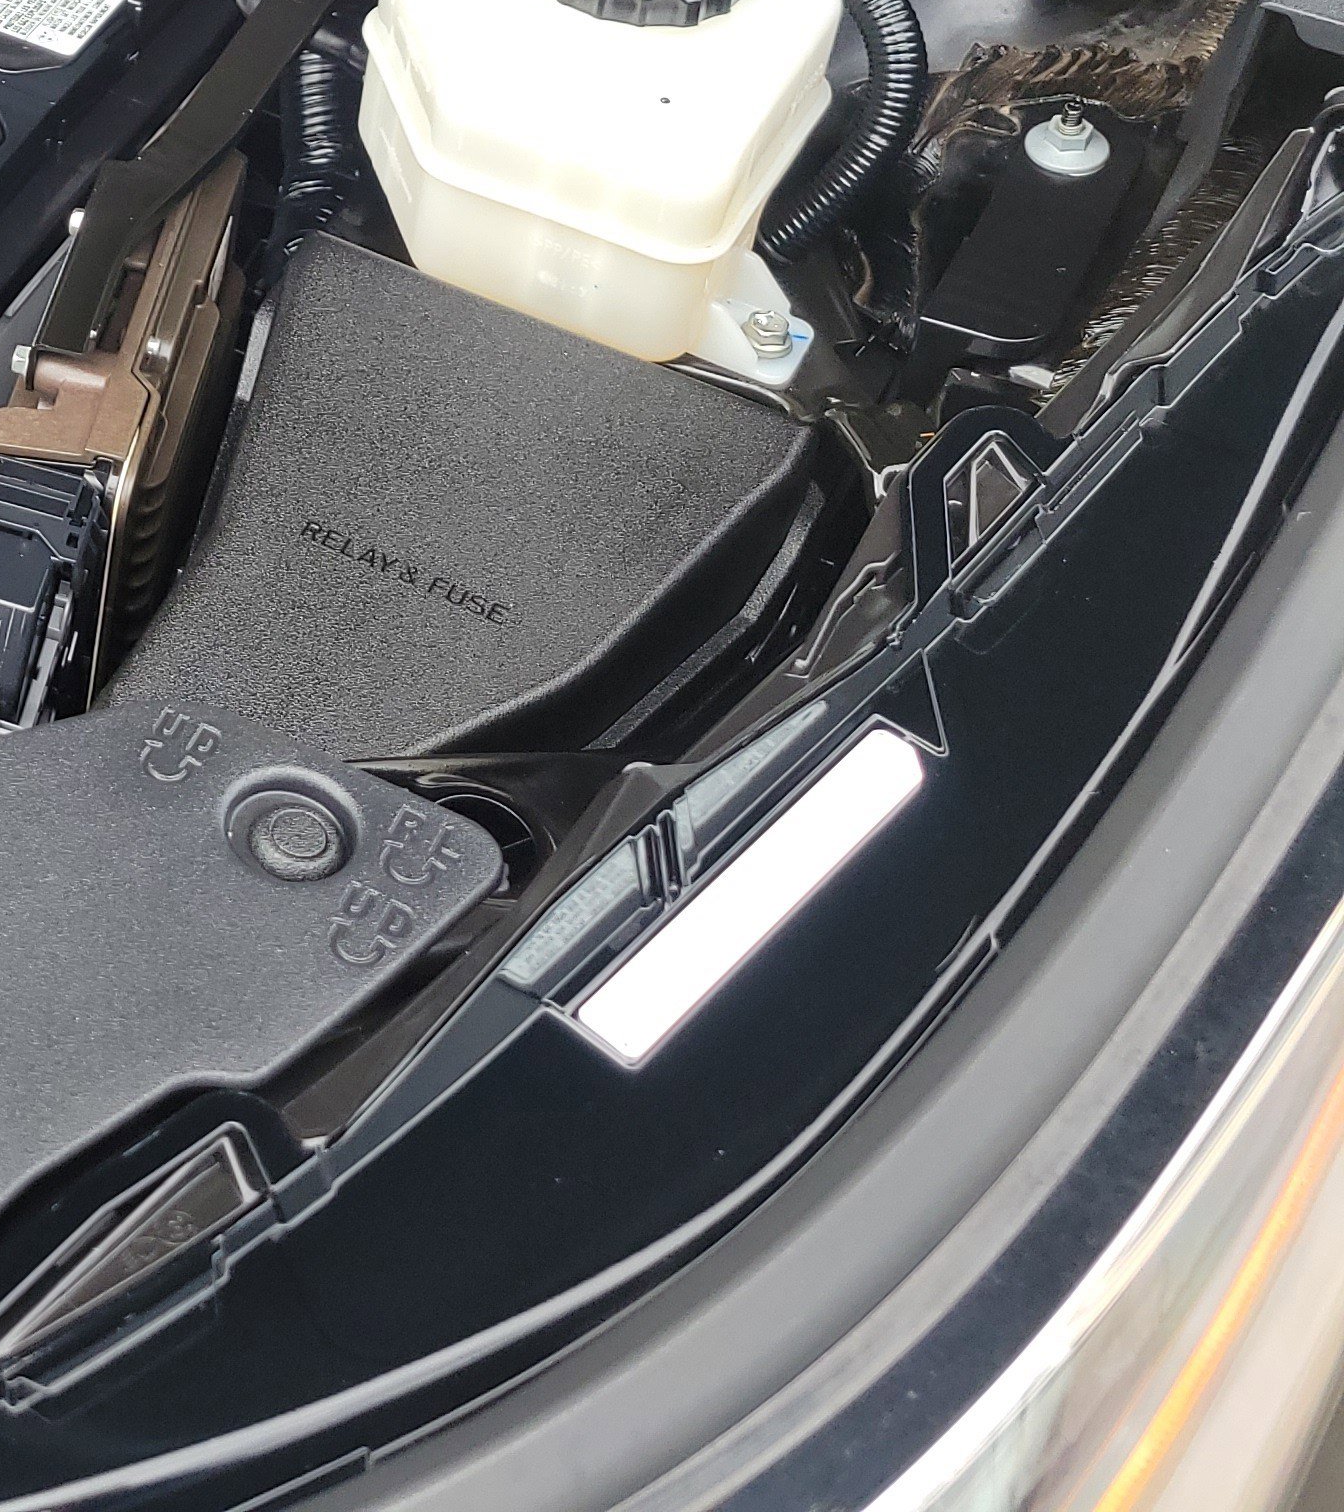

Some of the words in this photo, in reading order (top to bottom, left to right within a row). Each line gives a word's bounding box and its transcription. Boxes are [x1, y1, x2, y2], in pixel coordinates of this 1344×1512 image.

[299, 521, 400, 573] RELAY
[399, 563, 418, 585] &
[426, 577, 511, 625] FUSE
[152, 706, 223, 753] UP
[337, 880, 416, 936] UP
